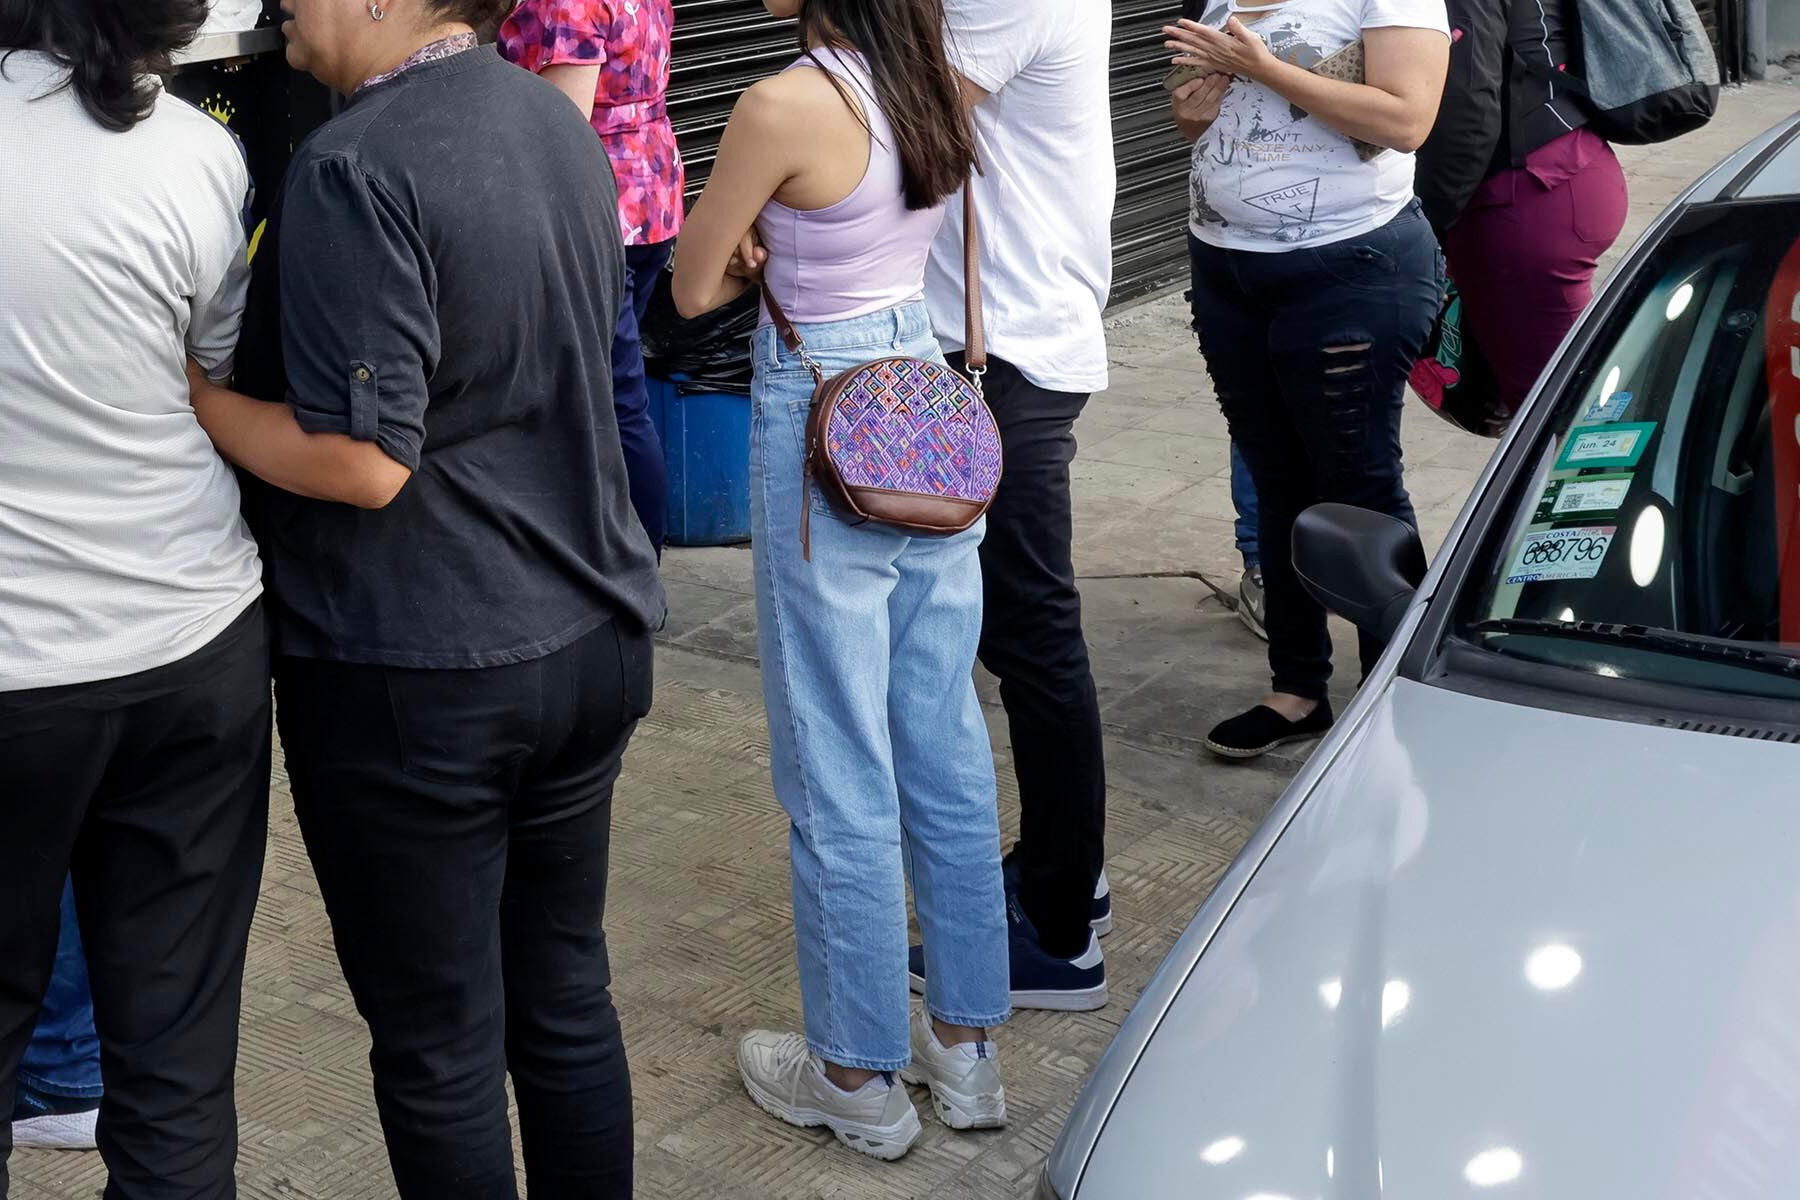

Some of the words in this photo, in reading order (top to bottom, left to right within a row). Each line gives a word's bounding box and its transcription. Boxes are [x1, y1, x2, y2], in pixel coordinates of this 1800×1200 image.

[1288, 143, 1327, 153] ANY
[1254, 153, 1291, 163] TIME
[1259, 185, 1310, 206] TRUE
[1289, 202, 1303, 213] T
[1602, 438, 1617, 448] 24
[1545, 530, 1577, 540] COSTA
